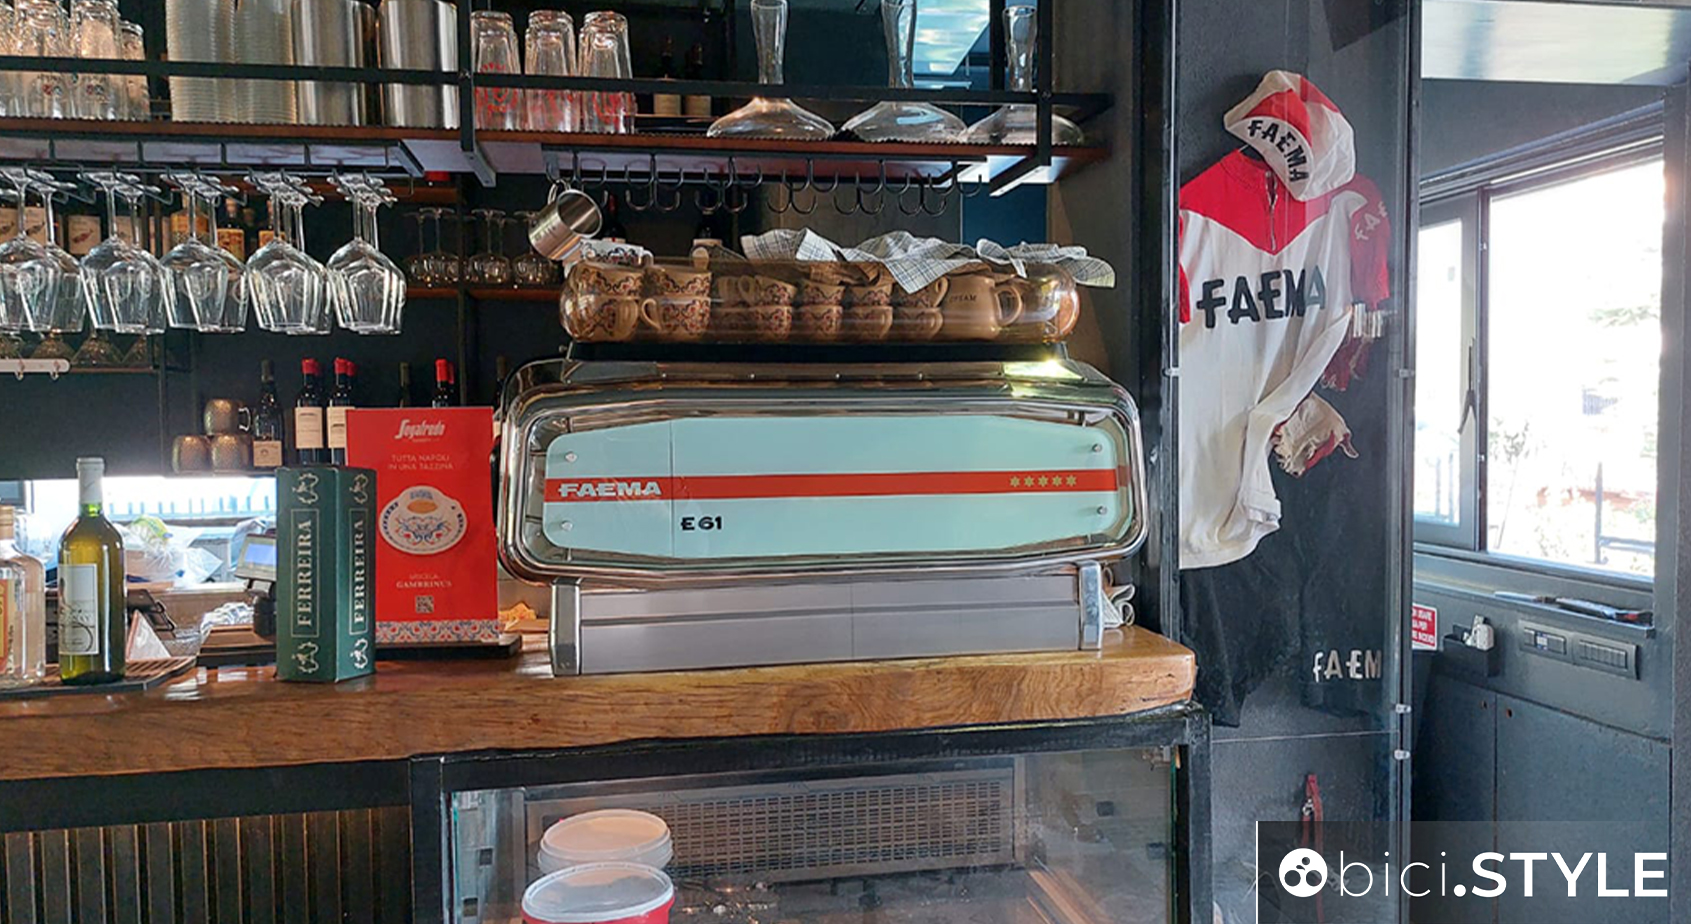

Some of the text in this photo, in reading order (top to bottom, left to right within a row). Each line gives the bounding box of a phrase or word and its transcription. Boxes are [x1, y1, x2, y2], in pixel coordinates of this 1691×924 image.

[1248, 119, 1310, 183] FAEMA
[1197, 265, 1326, 329] FAEMA
[558, 481, 661, 497] FAEMA
[297, 519, 312, 627] FERREIRA
[354, 520, 365, 624] FERREIRA
[1313, 650, 1382, 683] FAEM
